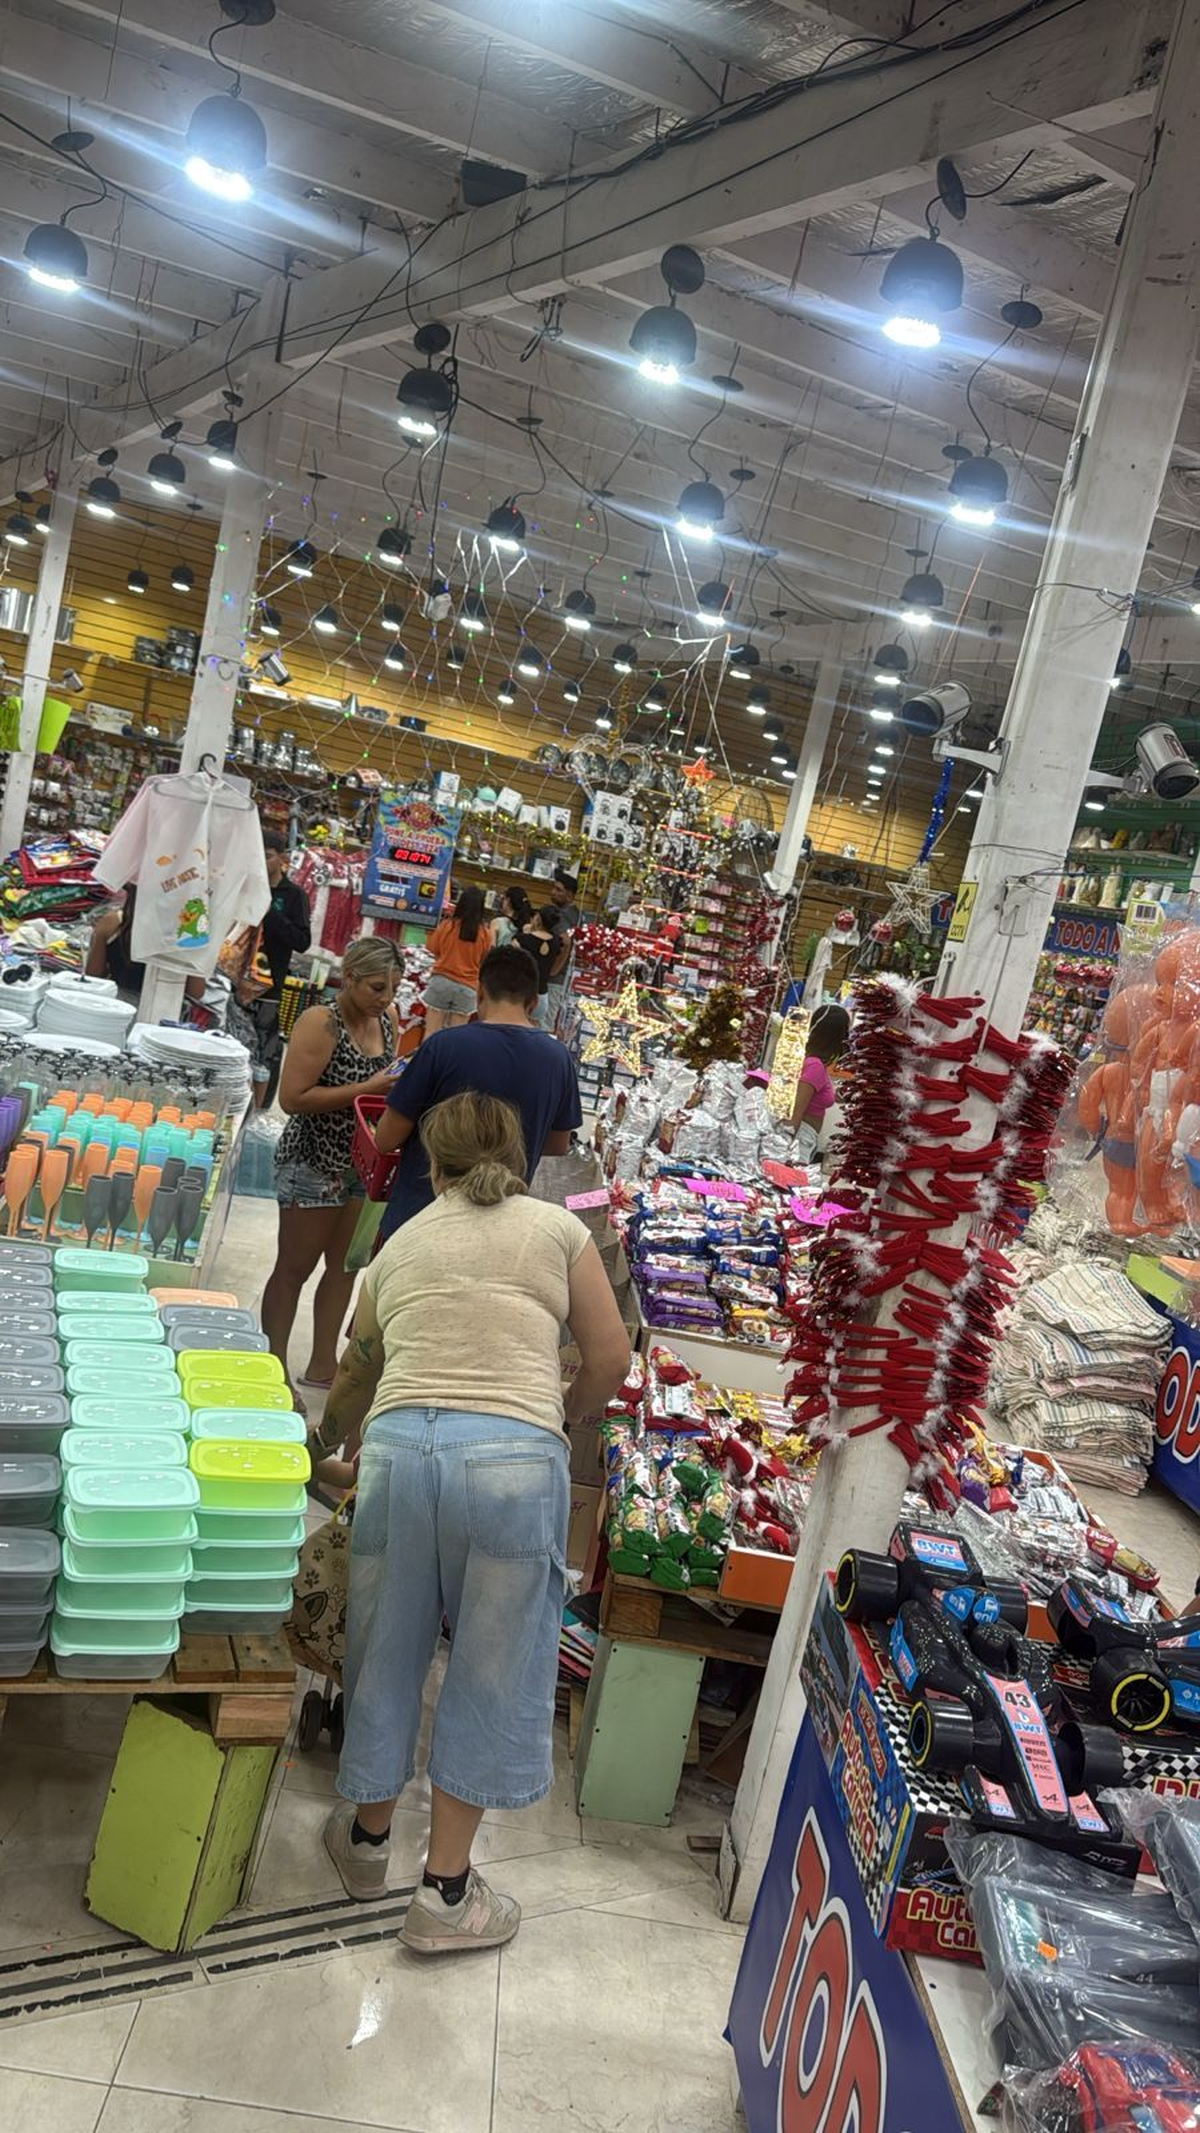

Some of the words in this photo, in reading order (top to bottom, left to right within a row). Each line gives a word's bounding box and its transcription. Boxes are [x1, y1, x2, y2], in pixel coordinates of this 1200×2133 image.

[379, 883, 406, 898] GRATIS
[1055, 919, 1097, 953] TODO
[1093, 926, 1109, 955] A
[916, 1538, 956, 1556] BWT
[974, 1611, 994, 1623] eni
[1004, 1691, 1032, 1709] 43
[1013, 1722, 1044, 1735] BWT
[936, 1920, 980, 1949] Car
[1135, 1973, 1154, 1983] 44
